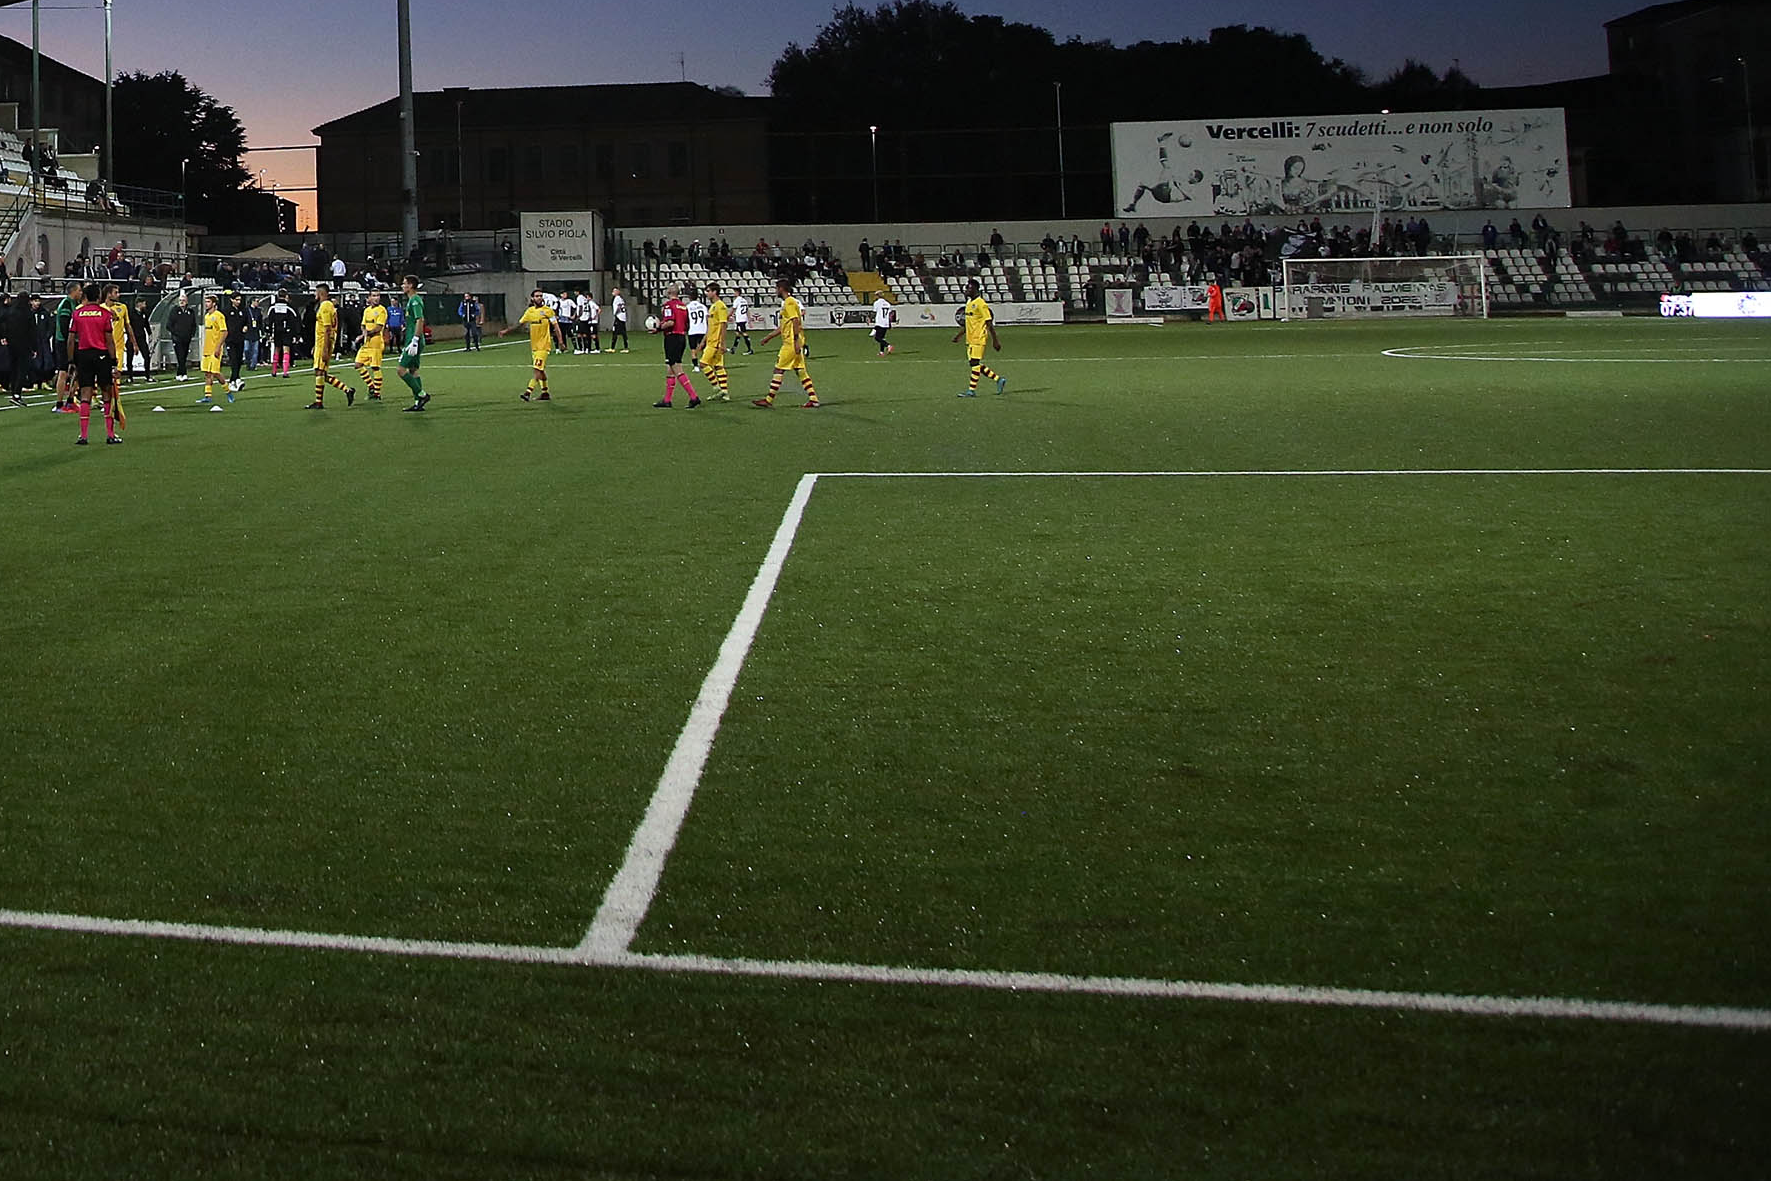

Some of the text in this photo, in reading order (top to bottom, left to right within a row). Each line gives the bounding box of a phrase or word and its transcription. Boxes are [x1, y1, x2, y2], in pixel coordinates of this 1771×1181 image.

[1205, 121, 1301, 140] Vercelli:
[1305, 122, 1317, 138] 7
[1405, 122, 1415, 135] e
[1418, 120, 1453, 134] non
[1456, 116, 1494, 133] solo
[539, 219, 573, 228] STADIO
[525, 229, 588, 239] SILVIO PIOLA
[1381, 295, 1421, 305] 2022
[690, 310, 705, 325] 99
